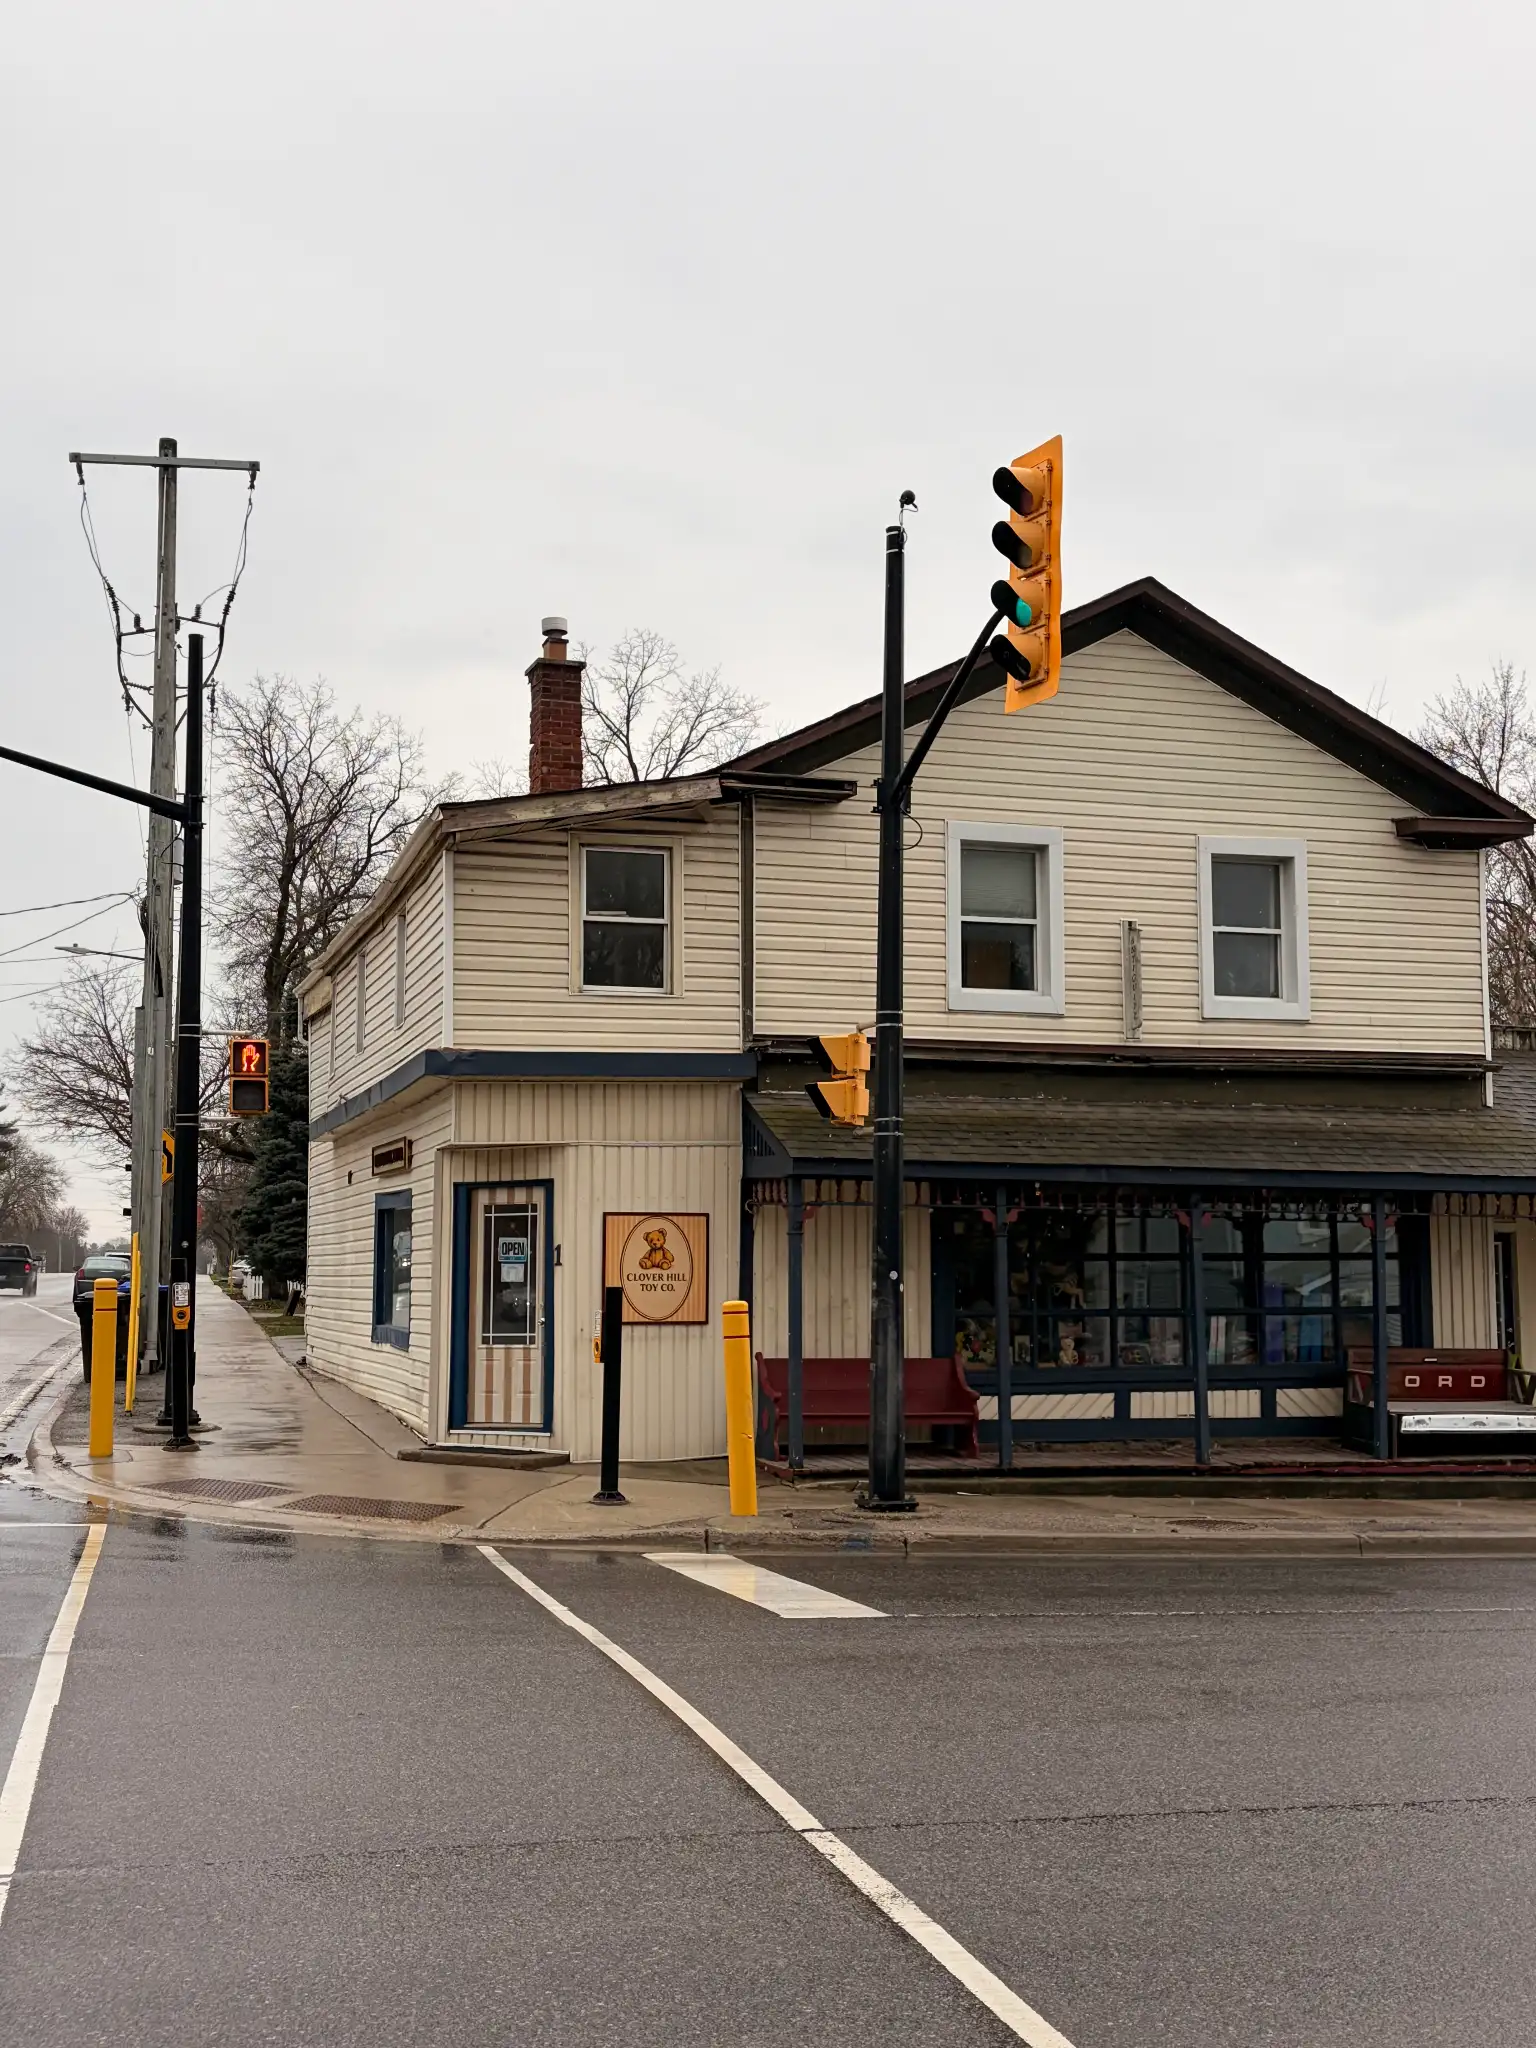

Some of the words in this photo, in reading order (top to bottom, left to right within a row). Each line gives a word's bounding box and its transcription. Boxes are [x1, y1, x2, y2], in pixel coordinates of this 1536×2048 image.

[501, 1241, 525, 1256] OPEN
[554, 1244, 563, 1266] 1
[626, 1272, 665, 1282] CLOVER
[666, 1272, 687, 1282] HILL
[640, 1283, 659, 1292] TOY
[660, 1283, 676, 1292] CO.
[1404, 1375, 1486, 1388] ORD
